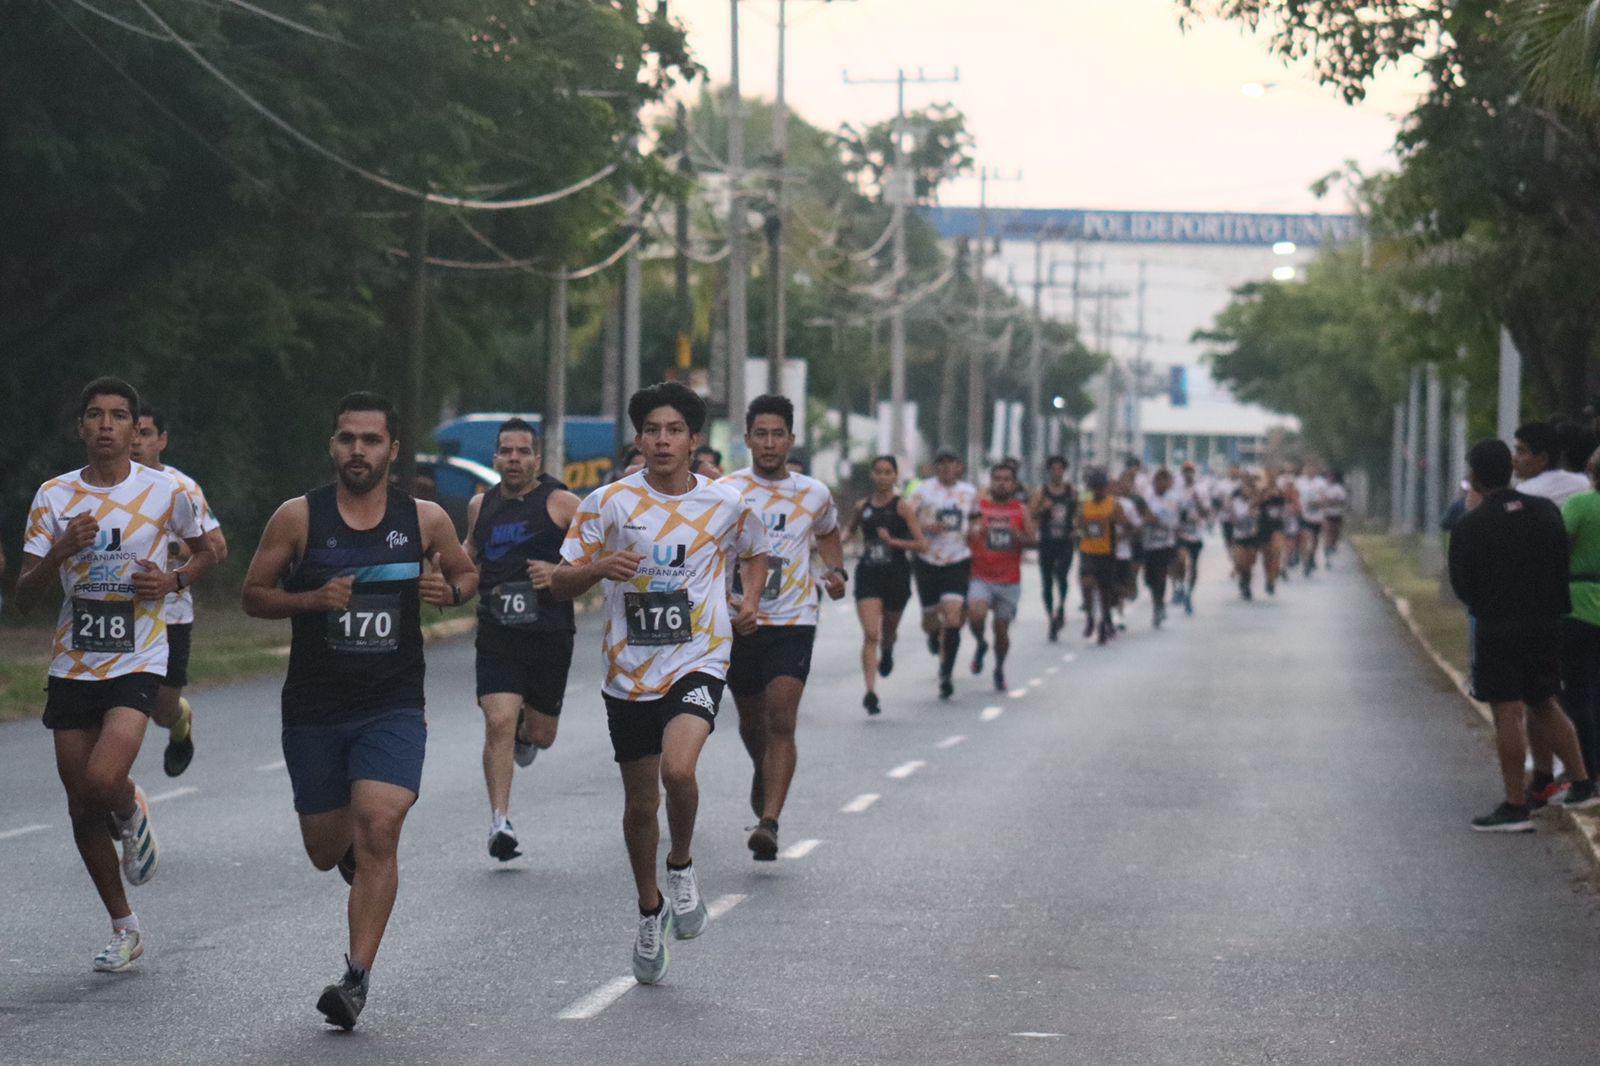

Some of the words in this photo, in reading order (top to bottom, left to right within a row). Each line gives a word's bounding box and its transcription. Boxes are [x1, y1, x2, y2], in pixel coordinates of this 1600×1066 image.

[653, 544, 686, 568] UJ
[89, 564, 121, 581] 5K
[74, 583, 137, 594] PREMIER
[500, 594, 526, 613] 76
[79, 613, 126, 639] 218
[338, 611, 392, 638] 170
[634, 605, 682, 631] 176
